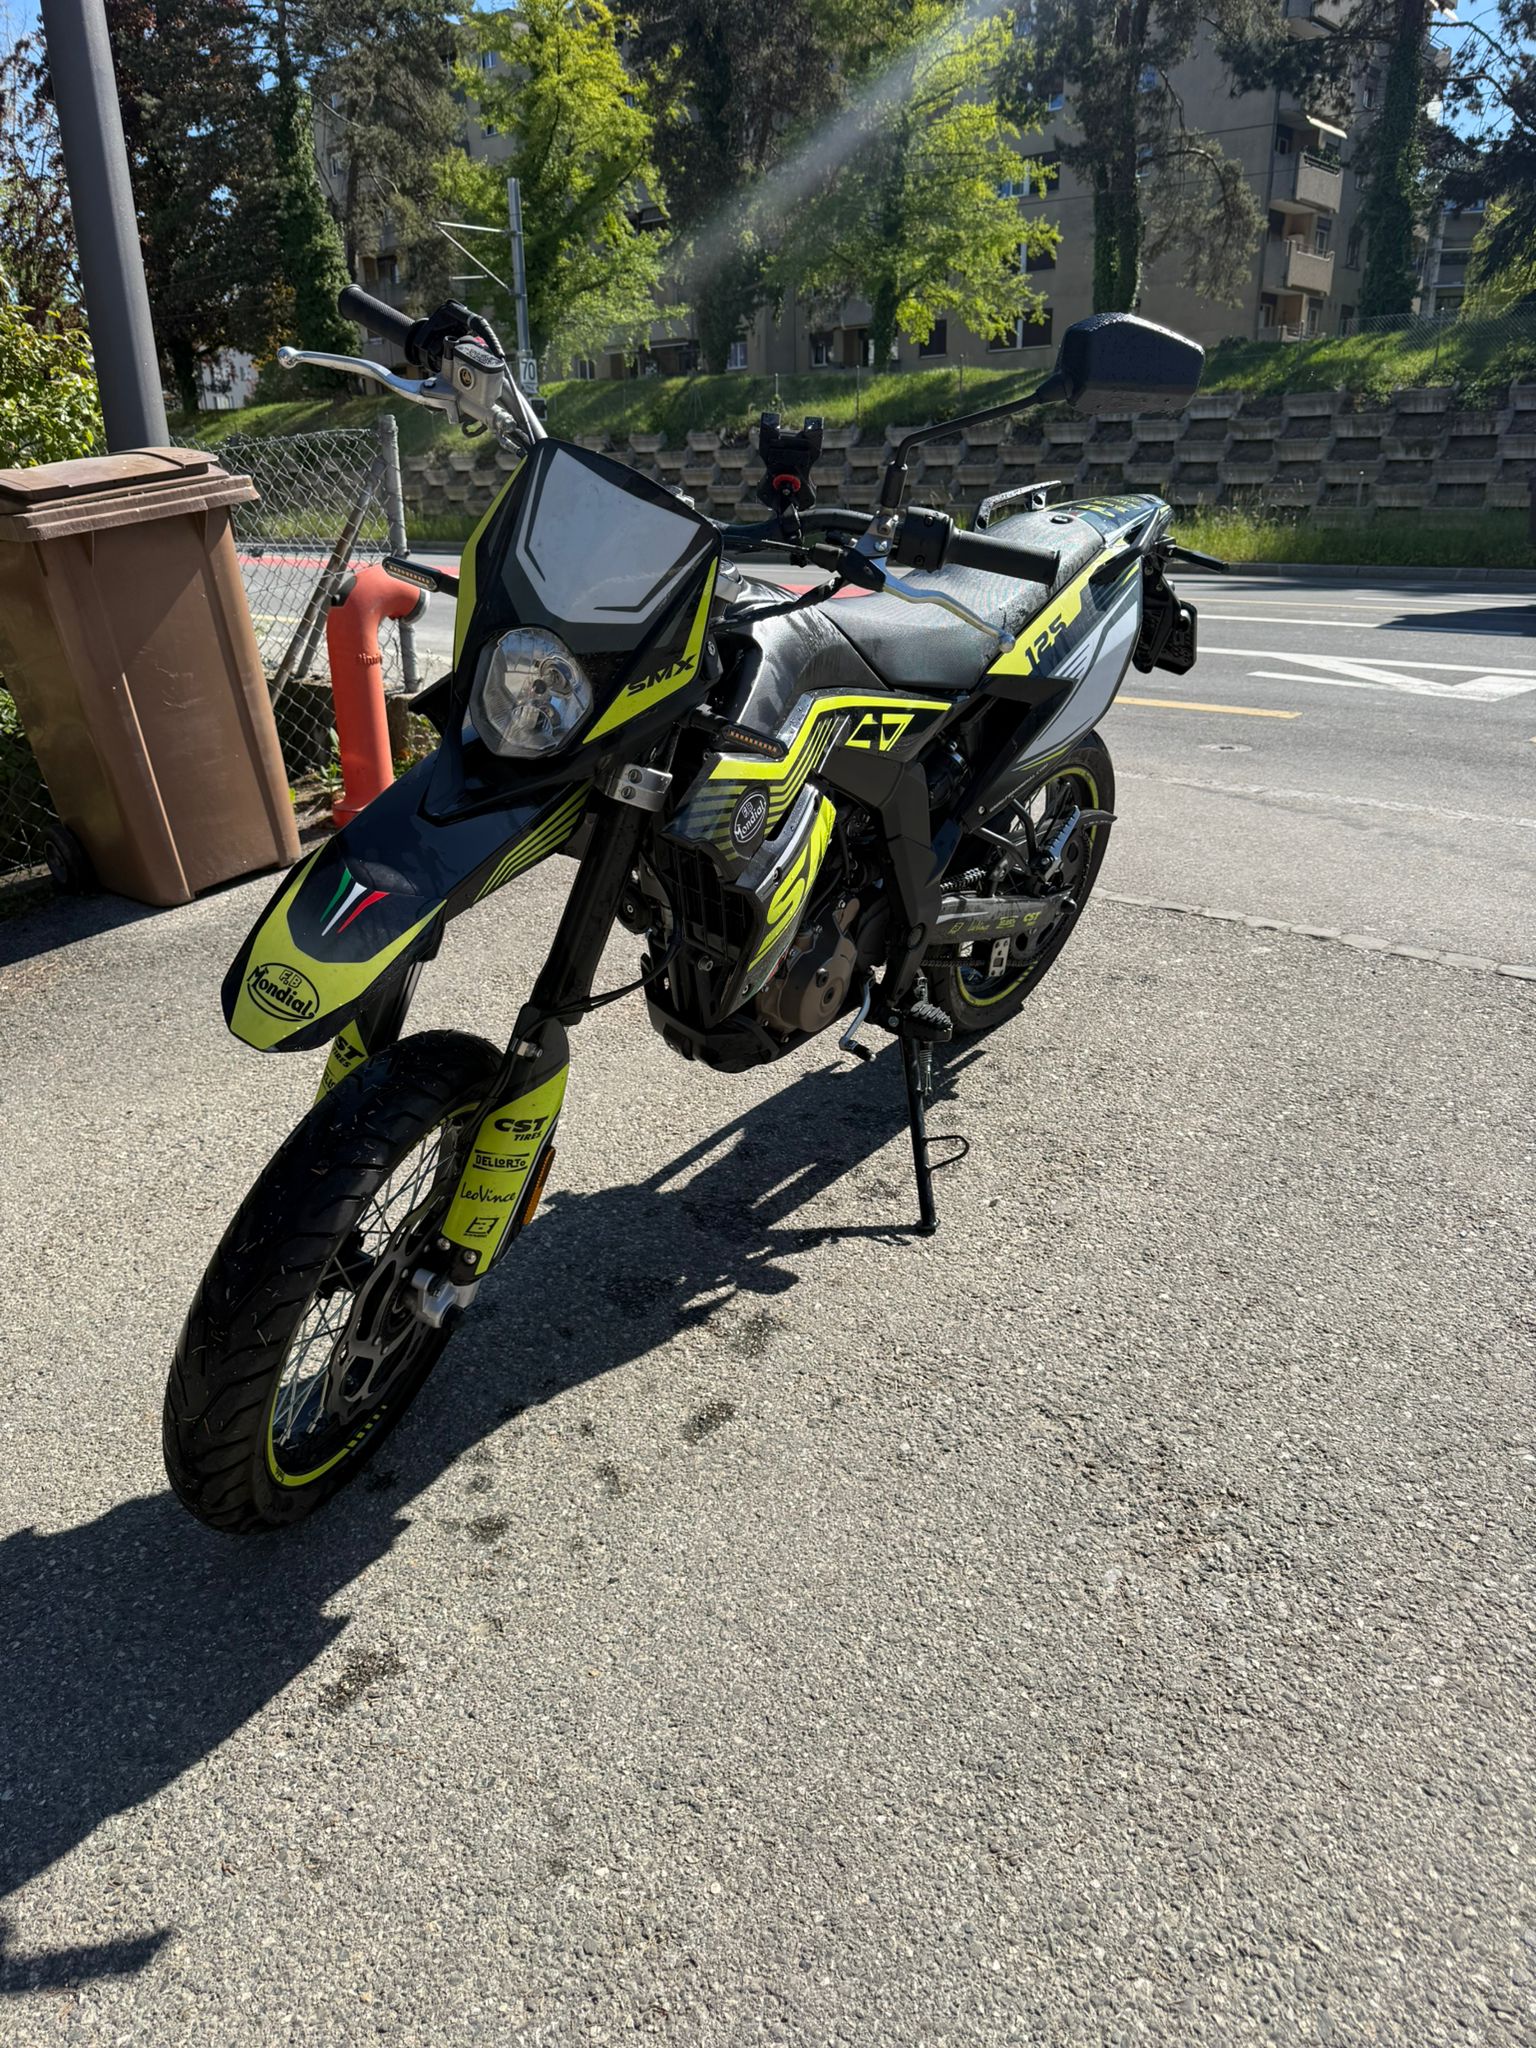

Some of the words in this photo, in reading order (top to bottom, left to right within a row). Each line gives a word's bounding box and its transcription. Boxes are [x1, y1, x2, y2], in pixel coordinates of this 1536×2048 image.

[521, 361, 536, 380] 70
[1025, 613, 1067, 672] 125
[627, 653, 697, 697] SMX
[734, 800, 767, 839] Mondial
[247, 966, 314, 1017] Mondial
[335, 1035, 366, 1060] ST
[494, 1115, 550, 1133] CST
[514, 1131, 543, 1141] TIRES
[461, 1182, 517, 1203] LeoVince
